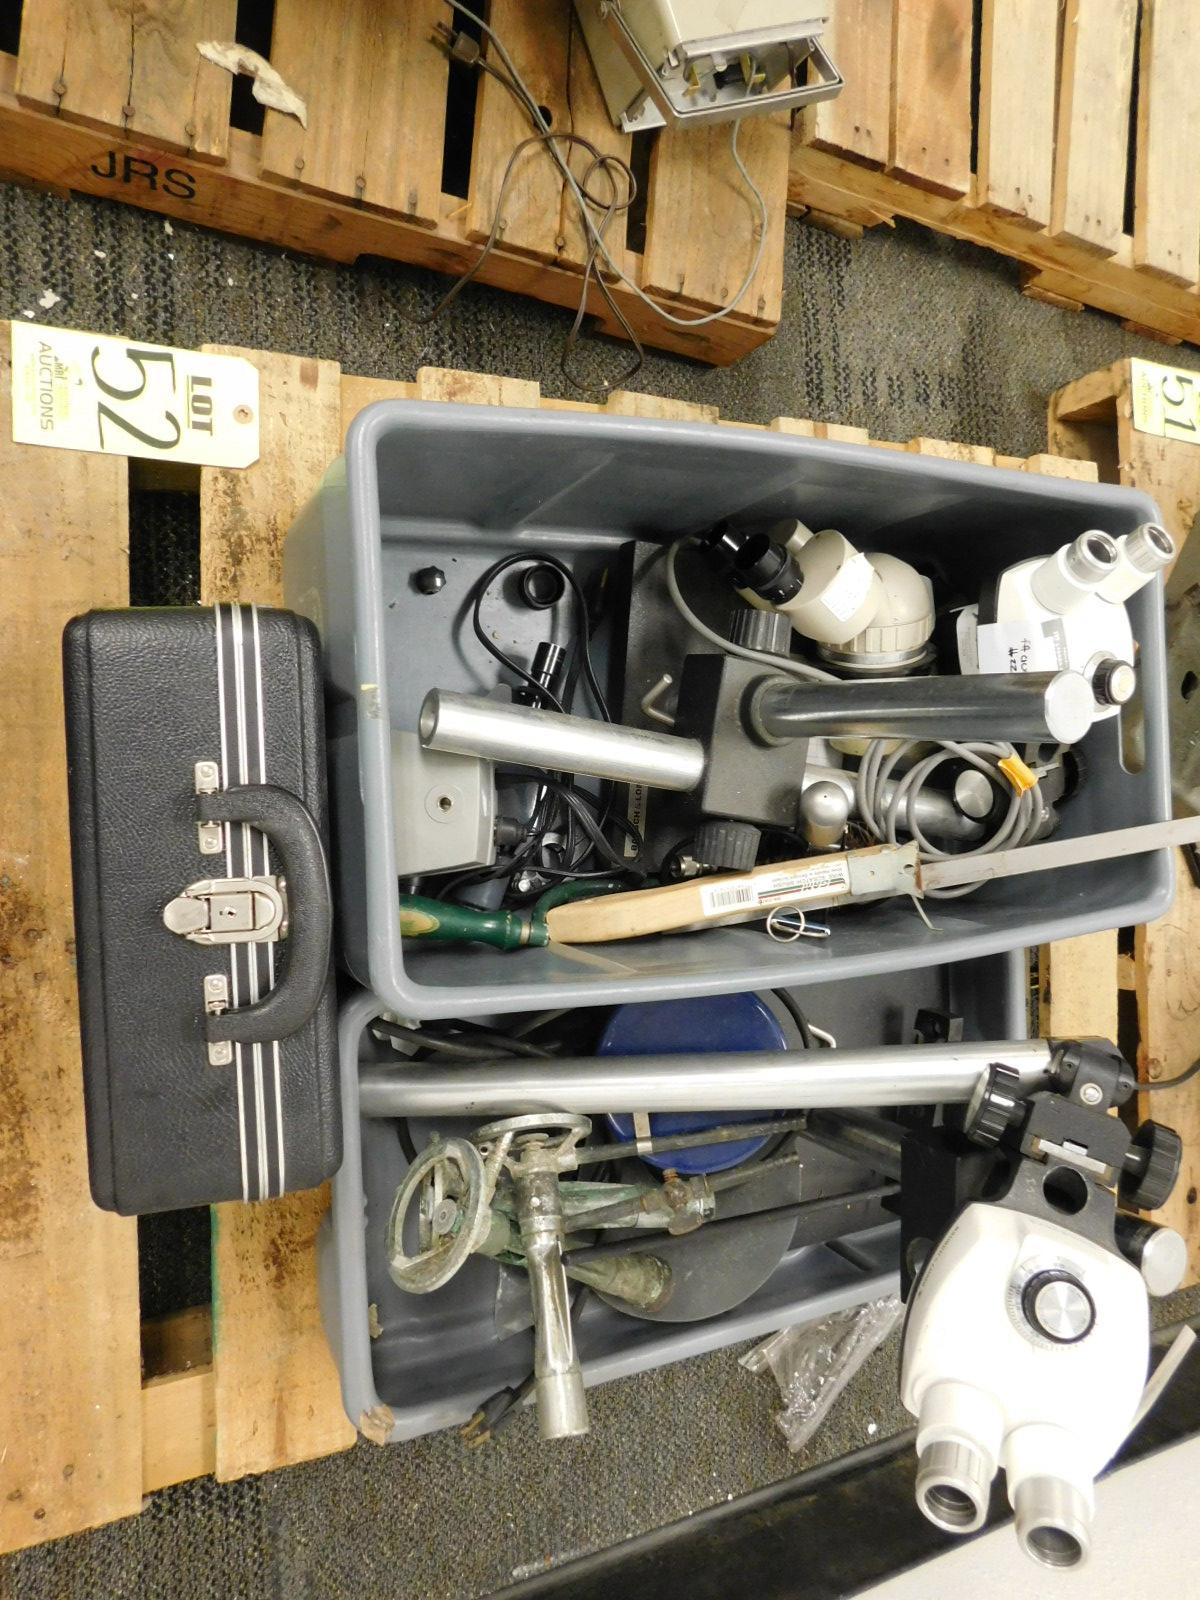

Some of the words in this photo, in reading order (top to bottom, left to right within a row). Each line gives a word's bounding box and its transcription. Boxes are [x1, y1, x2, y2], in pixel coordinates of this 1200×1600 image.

[91, 150, 196, 199] JRS
[38, 340, 54, 431] AUCTIONS
[90, 345, 182, 450] 52
[190, 374, 214, 437] LOT
[1161, 375, 1197, 438] 51
[631, 811, 641, 851] BACH
